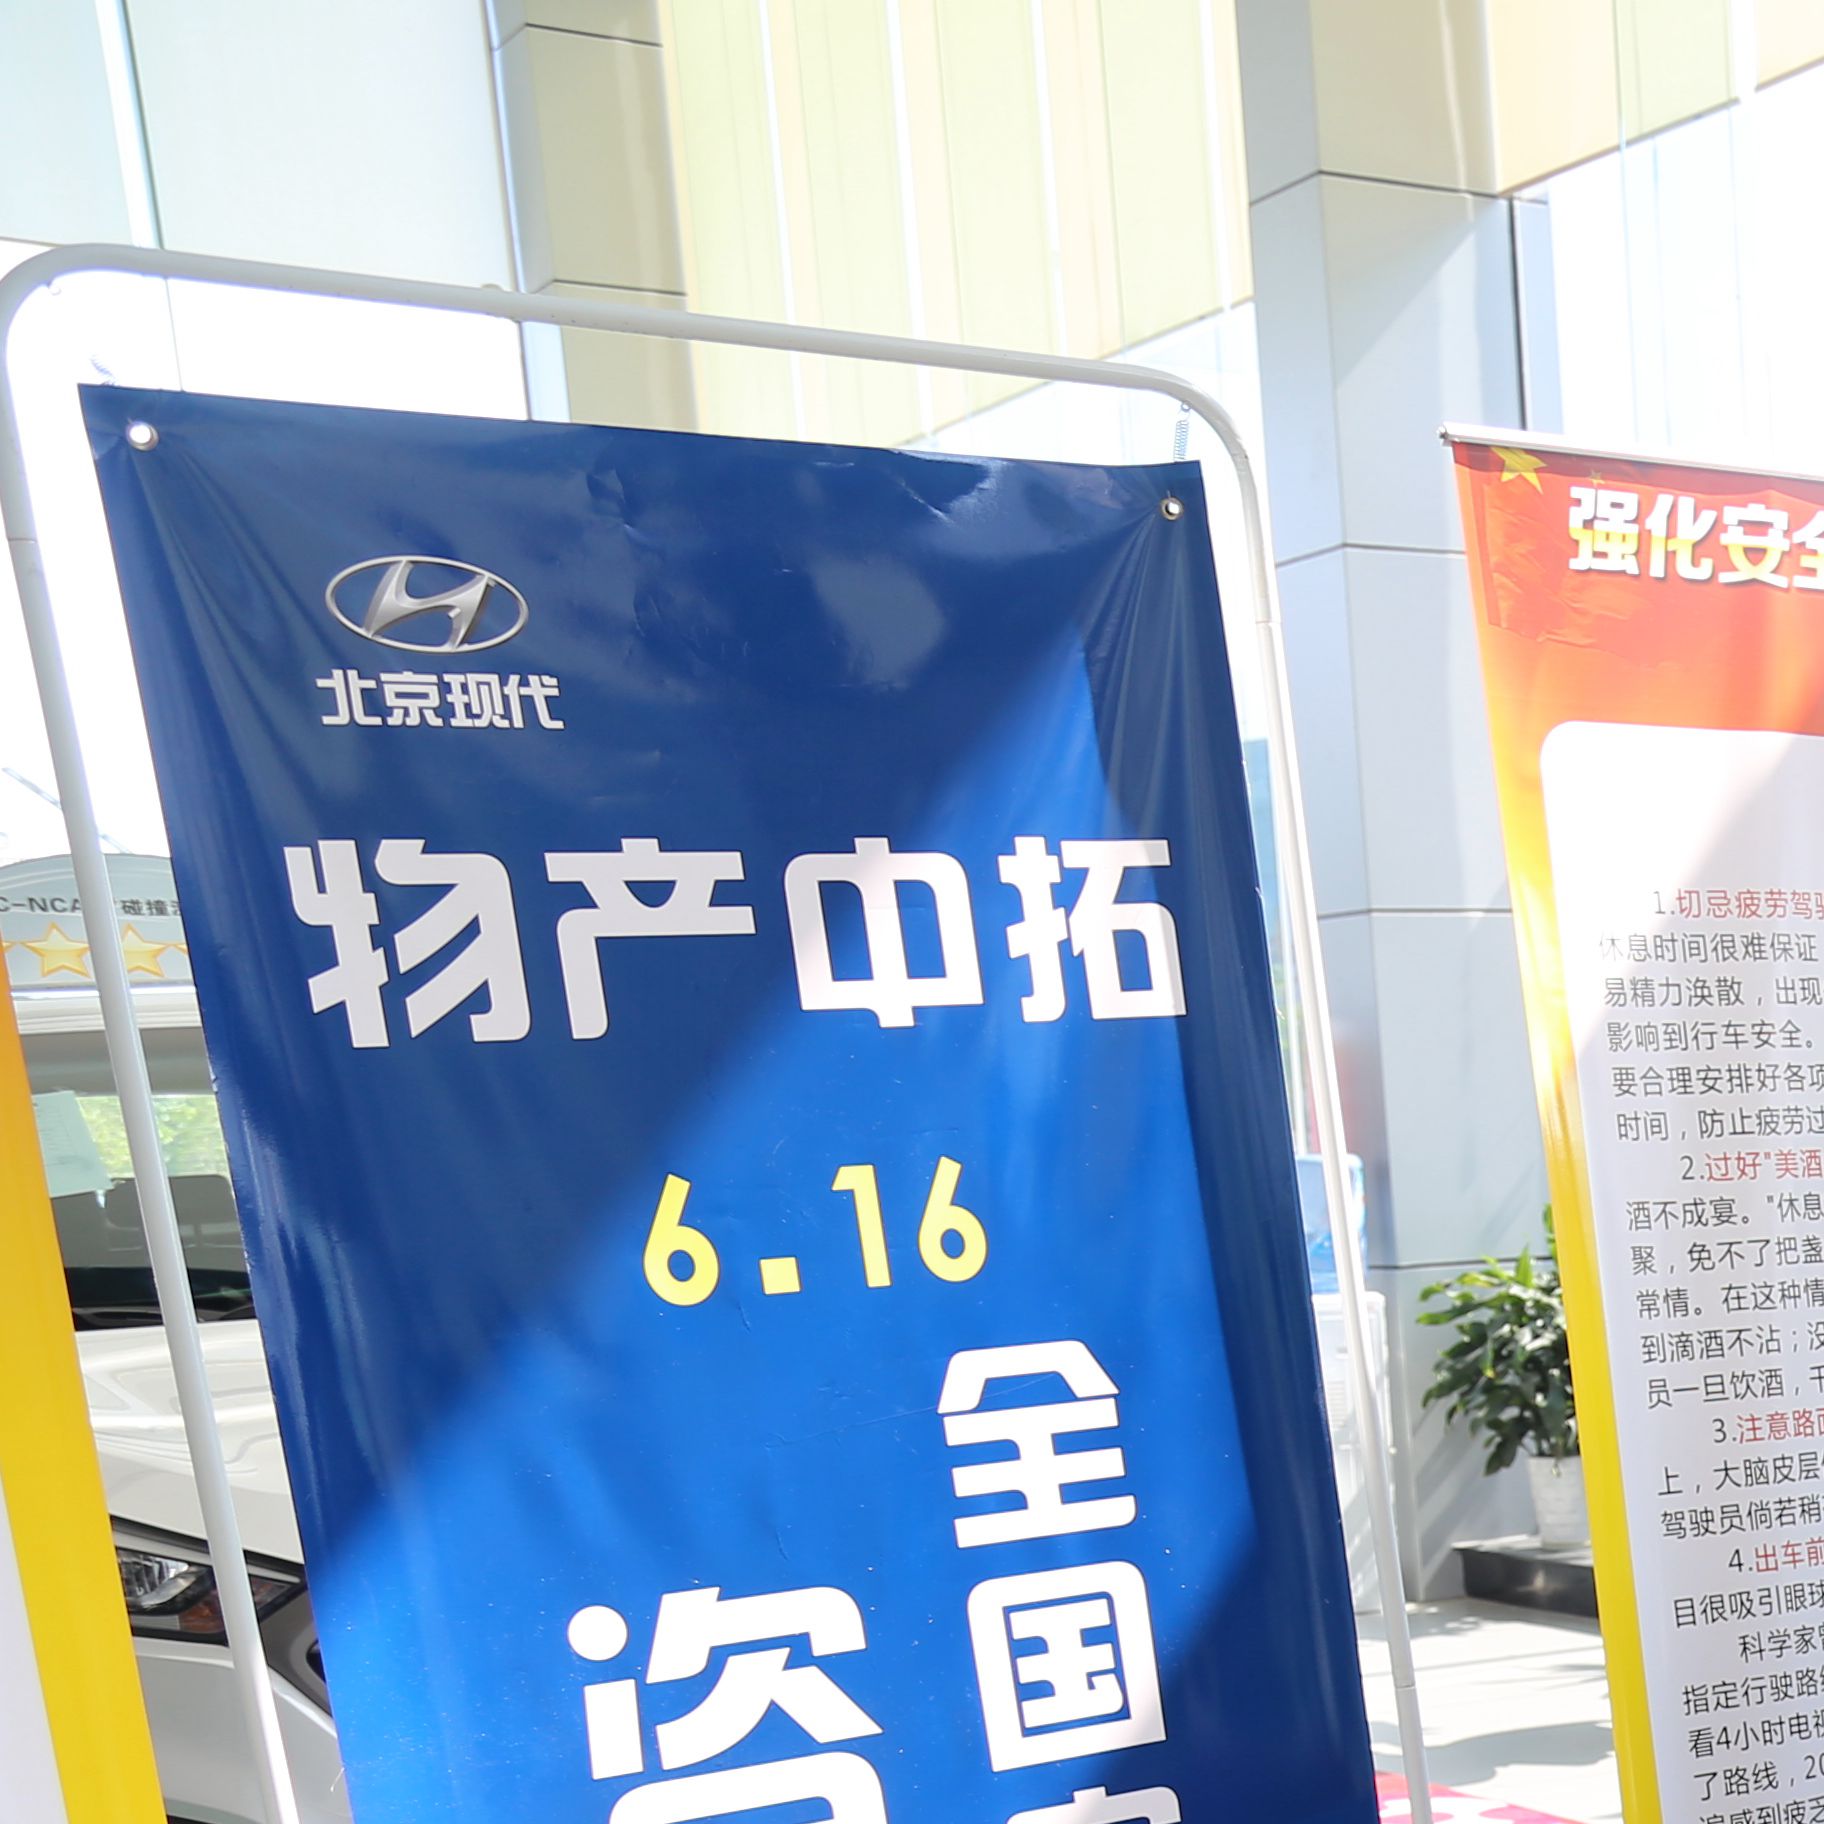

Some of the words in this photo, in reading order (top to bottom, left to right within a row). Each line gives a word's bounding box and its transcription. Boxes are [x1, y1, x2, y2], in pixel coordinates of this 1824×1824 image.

[314, 668, 565, 731] 北京现代
[283, 836, 1187, 1050] 物产中拓
[643, 1155, 988, 1307] 6.16
